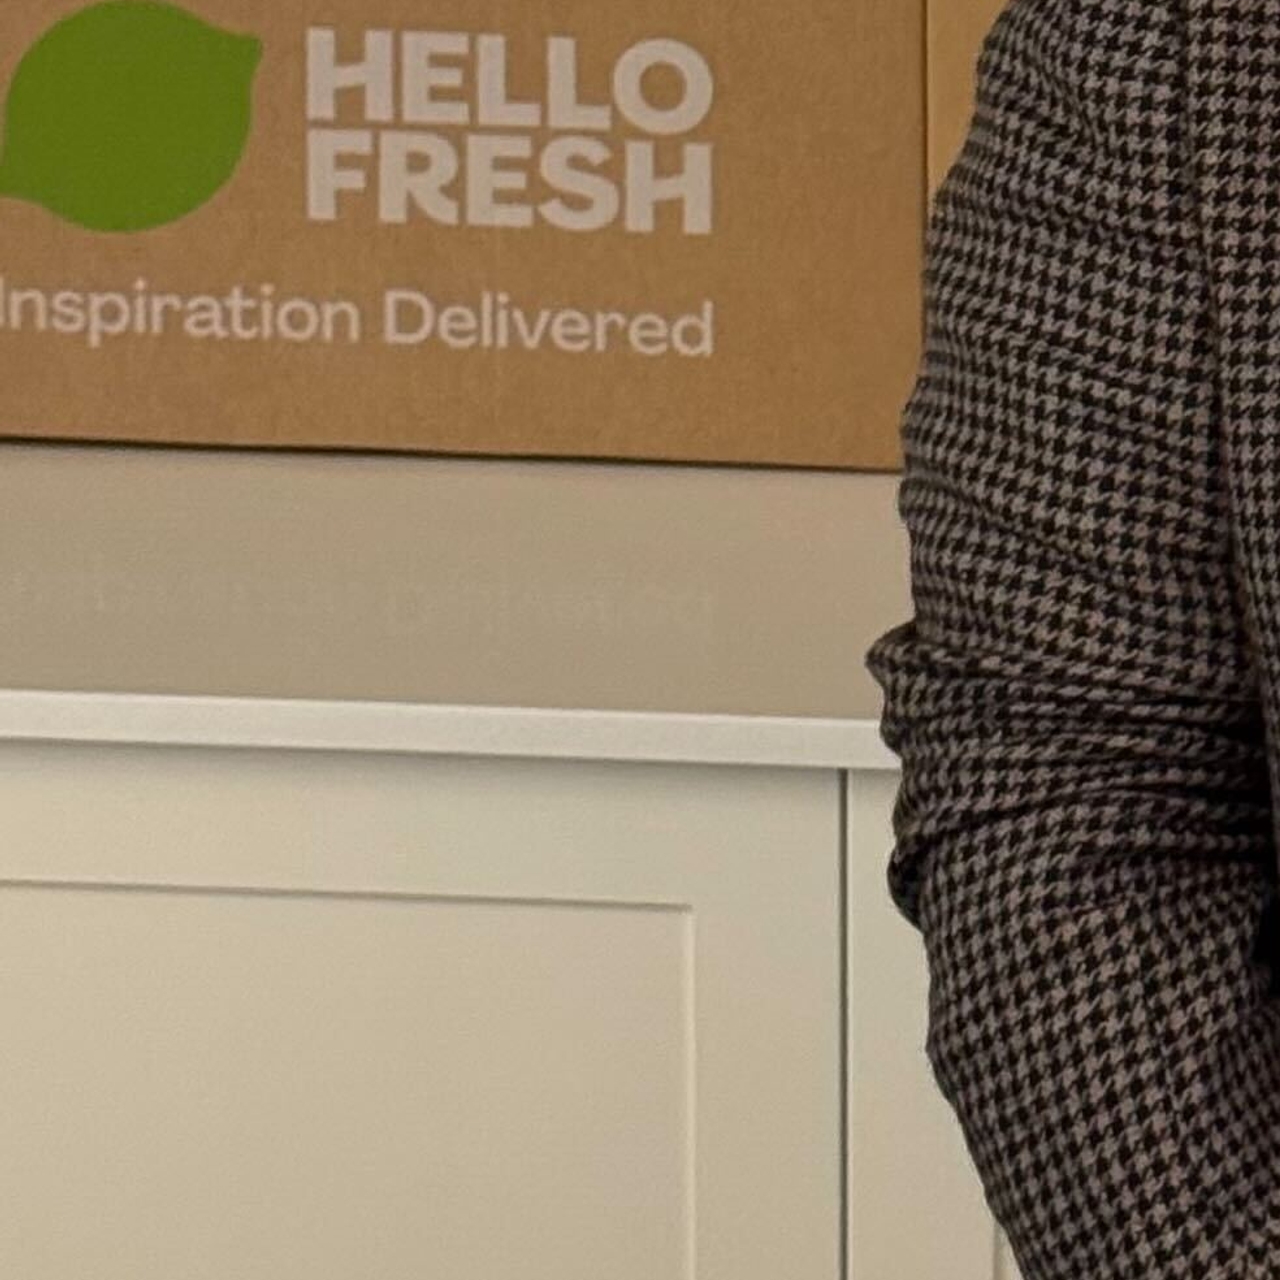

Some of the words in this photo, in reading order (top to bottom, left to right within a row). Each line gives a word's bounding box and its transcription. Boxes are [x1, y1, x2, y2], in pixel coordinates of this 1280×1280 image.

[304, 28, 714, 135] HELLO
[304, 128, 713, 236] FRESH
[0, 277, 361, 348] Inspiration
[383, 290, 714, 358] Delivered
